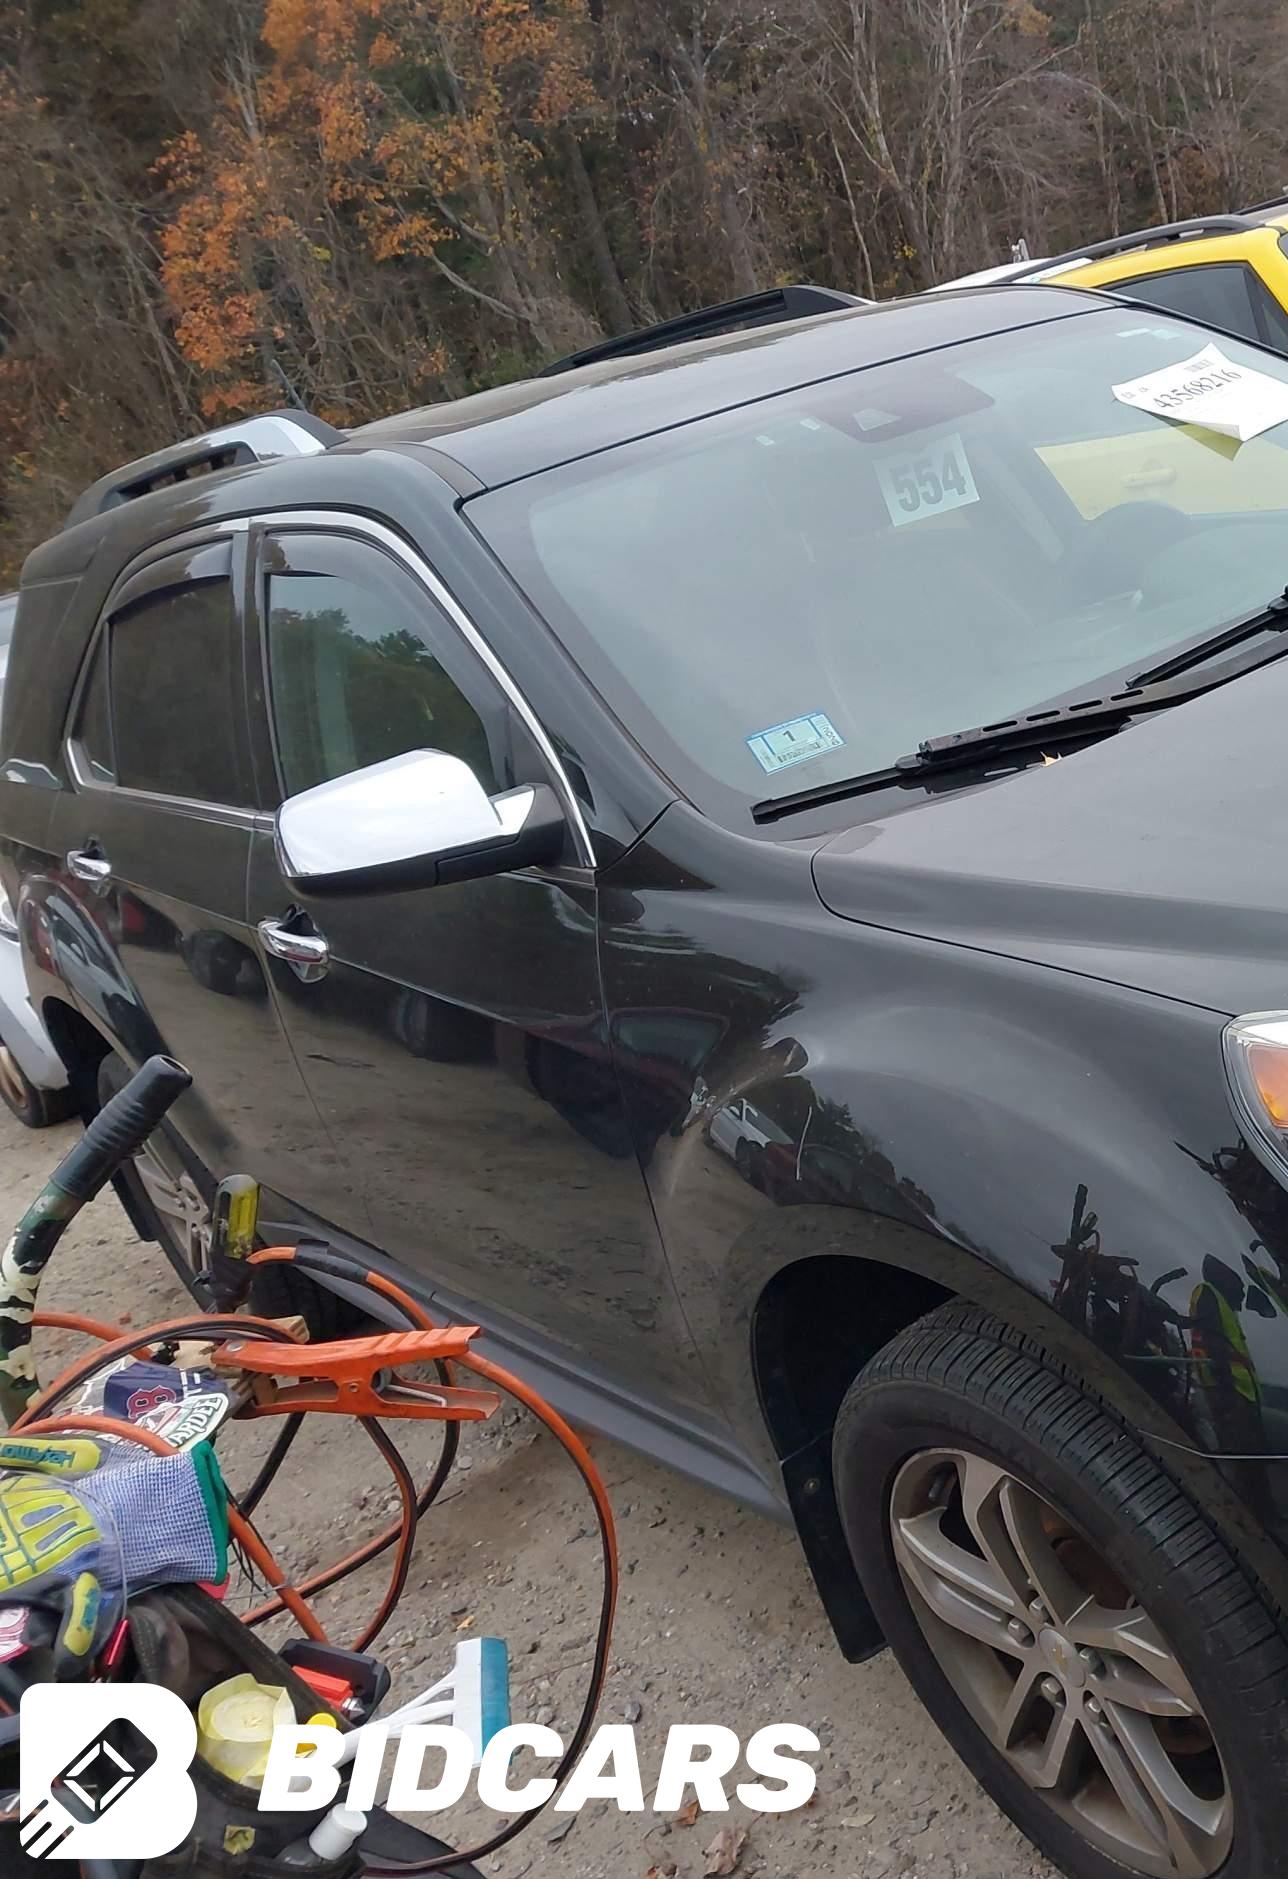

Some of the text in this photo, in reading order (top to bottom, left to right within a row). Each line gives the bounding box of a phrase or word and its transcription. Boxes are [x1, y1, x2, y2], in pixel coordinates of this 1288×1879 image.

[1153, 369, 1242, 408] 43568216
[889, 451, 967, 512] 554
[782, 730, 796, 742] 1
[0, 1443, 76, 1468] HexArmo
